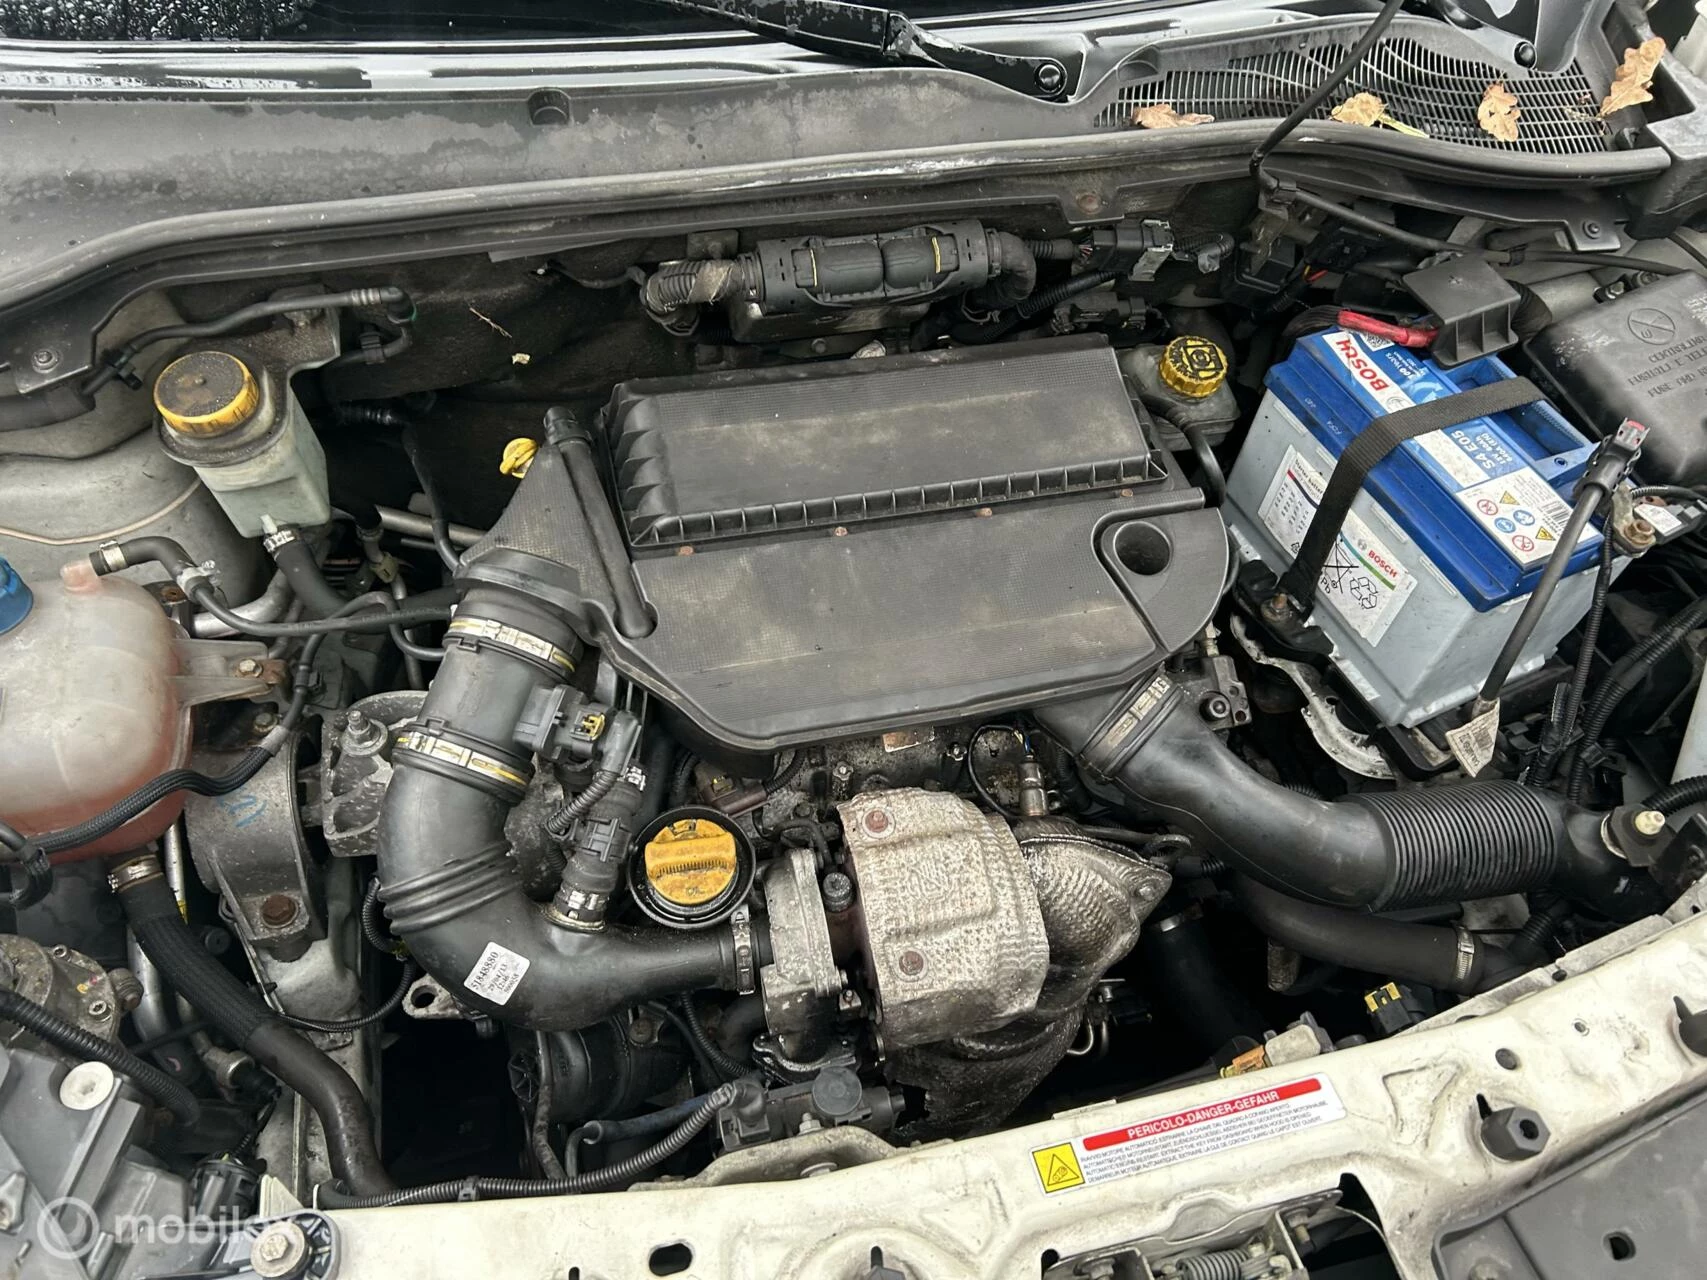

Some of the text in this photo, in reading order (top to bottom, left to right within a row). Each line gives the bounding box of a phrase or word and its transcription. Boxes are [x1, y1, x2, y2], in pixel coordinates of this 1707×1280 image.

[1336, 339, 1390, 391] BOSCH
[1450, 429, 1496, 470] S4 E05
[1307, 477, 1323, 495] batter
[1368, 550, 1398, 578] BOSCH
[1320, 577, 1331, 594] Pb
[470, 951, 498, 990] 51848880
[1128, 1091, 1280, 1139] PERICOLO-DANGER-GEFAHR
